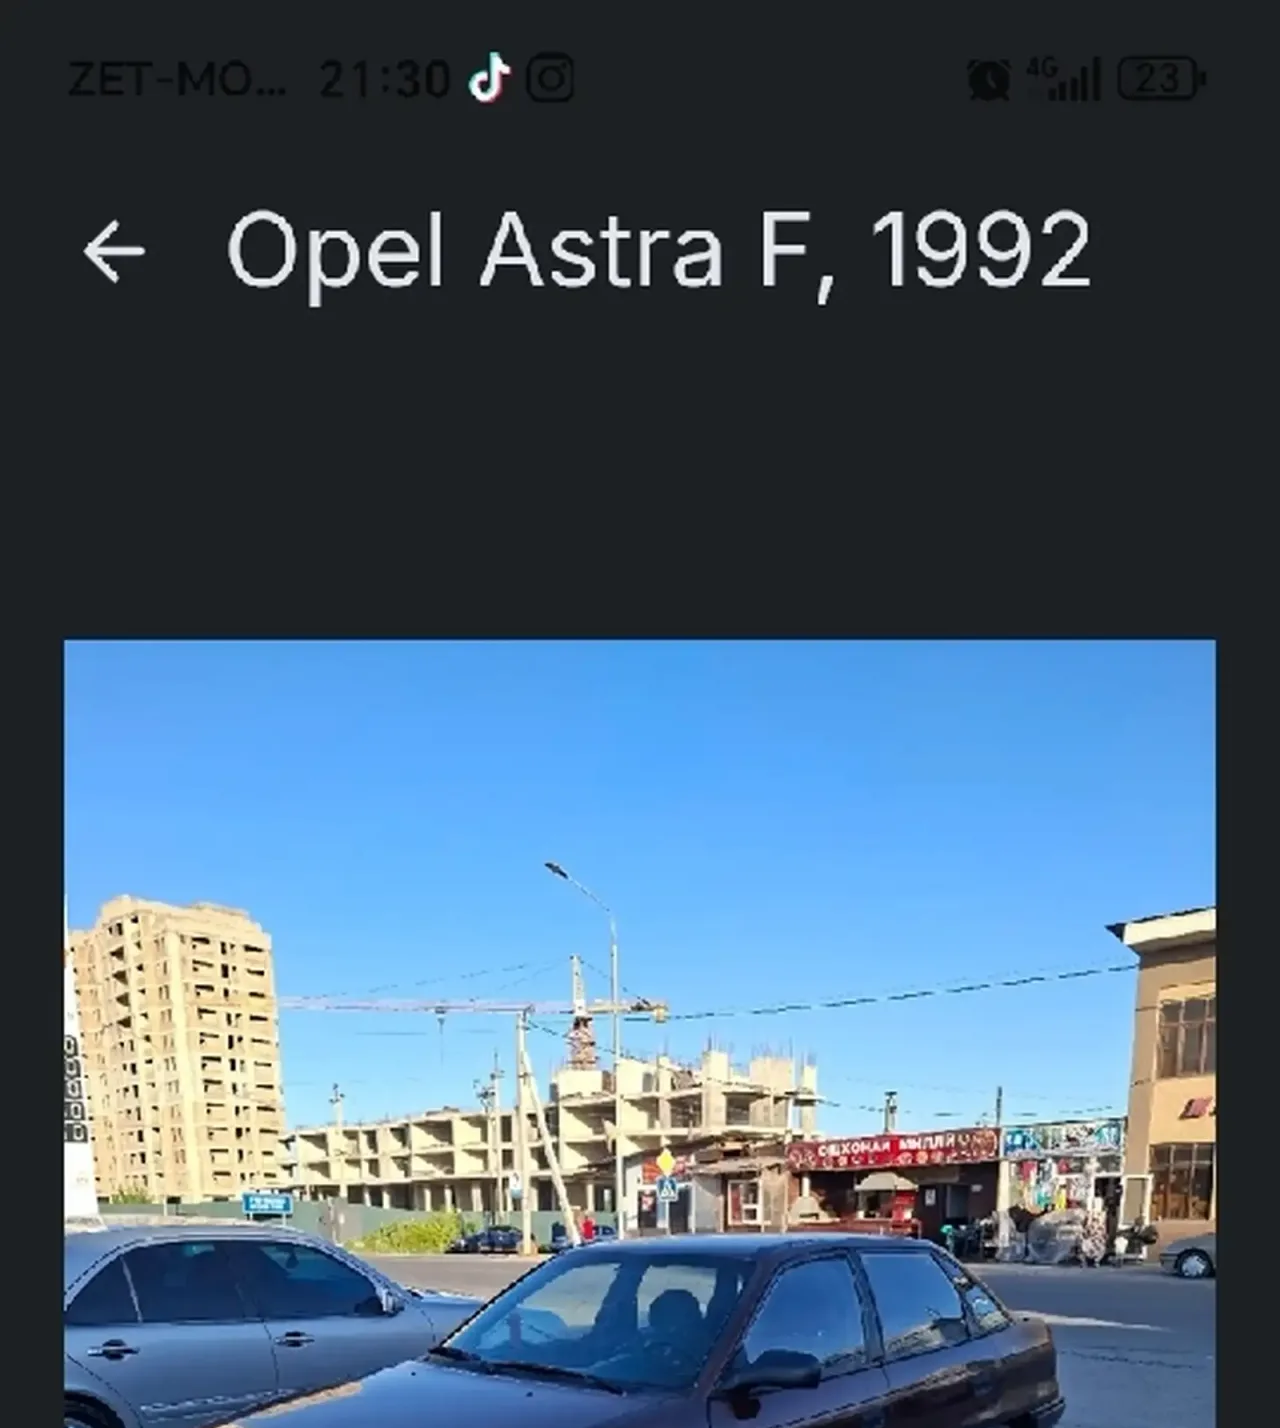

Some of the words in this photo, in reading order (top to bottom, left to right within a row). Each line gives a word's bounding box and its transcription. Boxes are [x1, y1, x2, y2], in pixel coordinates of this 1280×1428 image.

[319, 59, 450, 98] 21:30
[1026, 56, 1059, 78] 4G
[1136, 62, 1179, 93] 23
[227, 209, 442, 308] Opel
[479, 210, 723, 289] Astra
[762, 210, 834, 306] F,
[873, 209, 1091, 289] 1992
